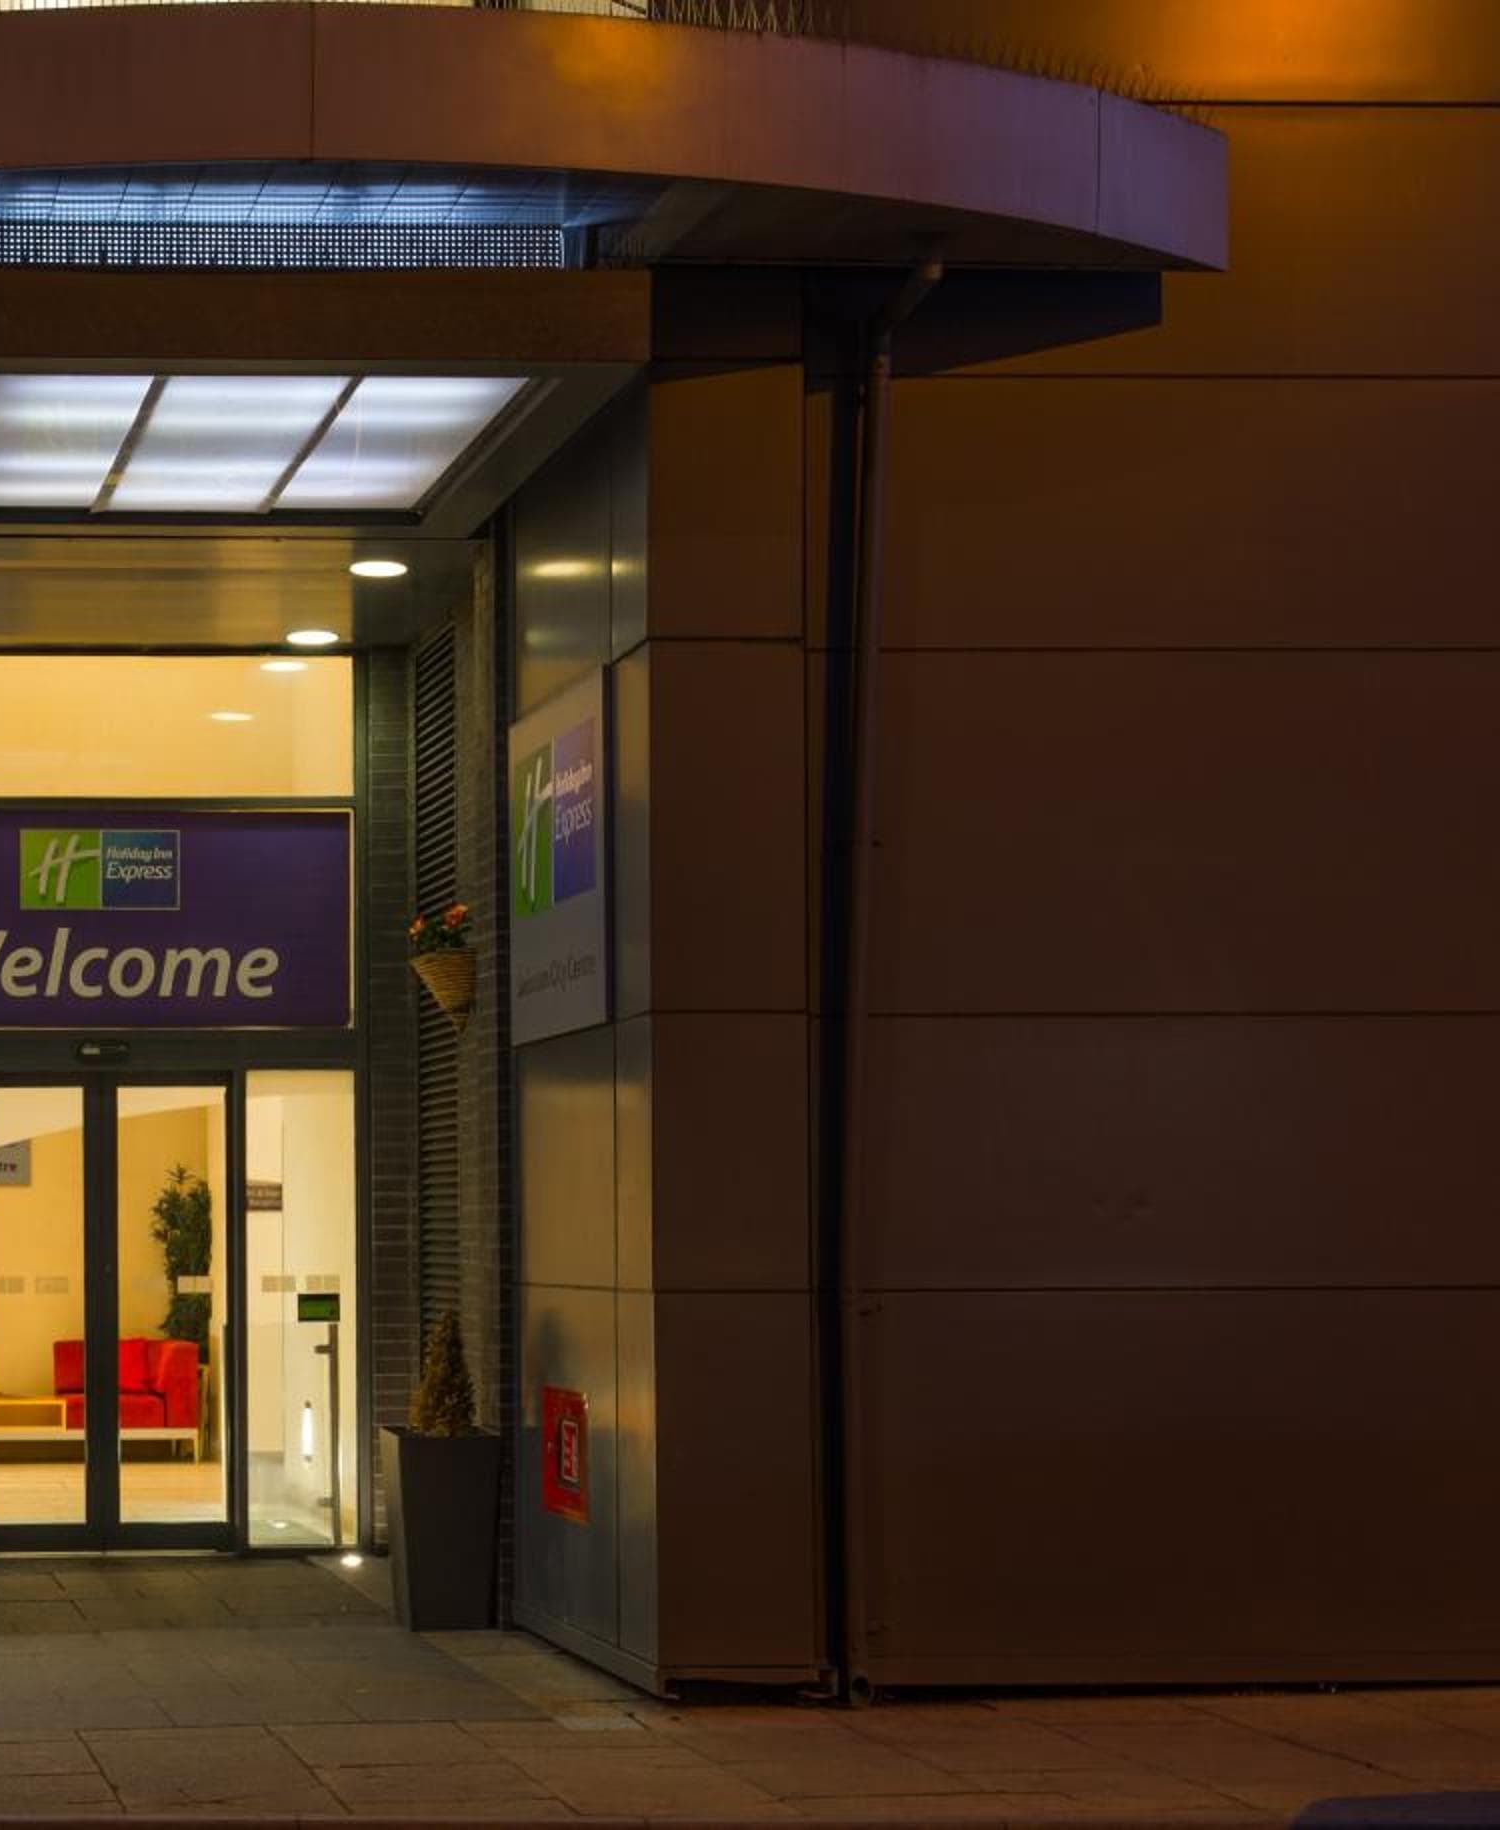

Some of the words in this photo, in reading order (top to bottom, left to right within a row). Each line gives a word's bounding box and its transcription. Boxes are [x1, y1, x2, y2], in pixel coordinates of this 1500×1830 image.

[106, 846, 153, 862] Holiday
[154, 846, 173, 860] Inn
[105, 861, 173, 883] Express
